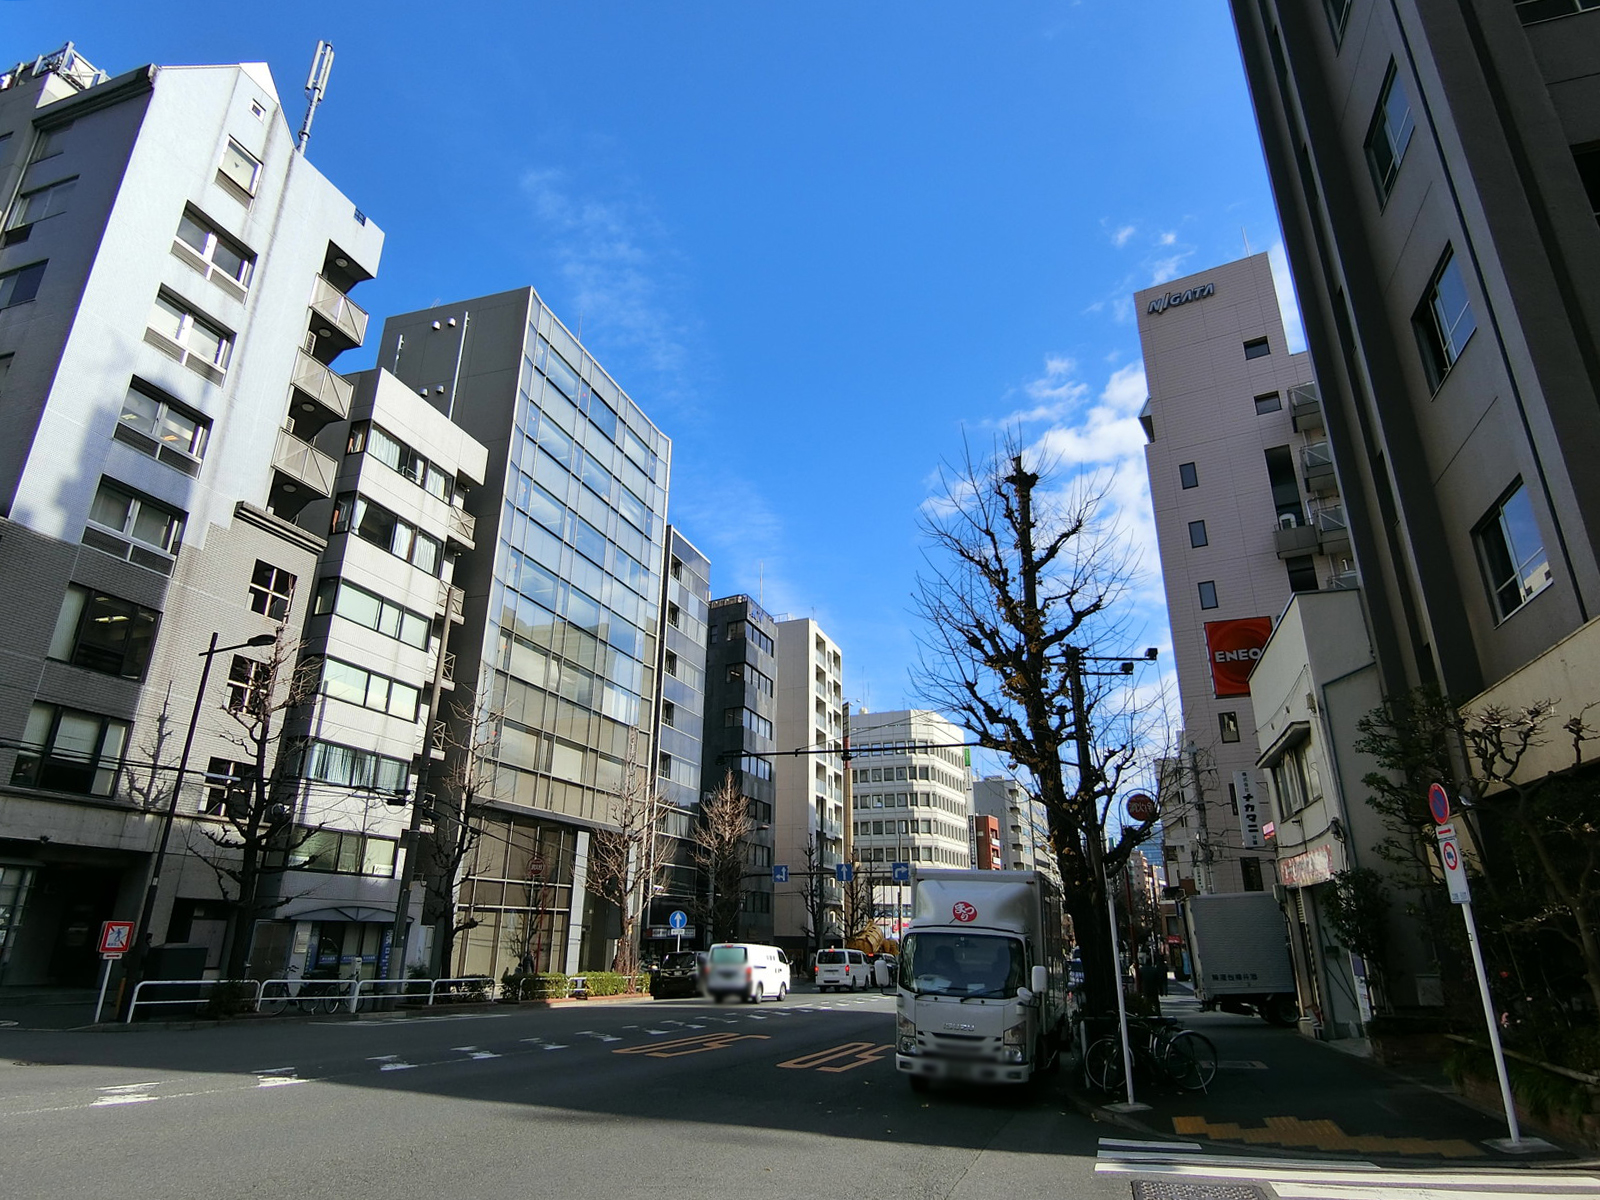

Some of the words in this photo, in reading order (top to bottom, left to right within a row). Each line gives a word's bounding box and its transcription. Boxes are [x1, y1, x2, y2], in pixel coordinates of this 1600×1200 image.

[1214, 648, 1263, 663] ENEO
[954, 902, 975, 921] まつり
